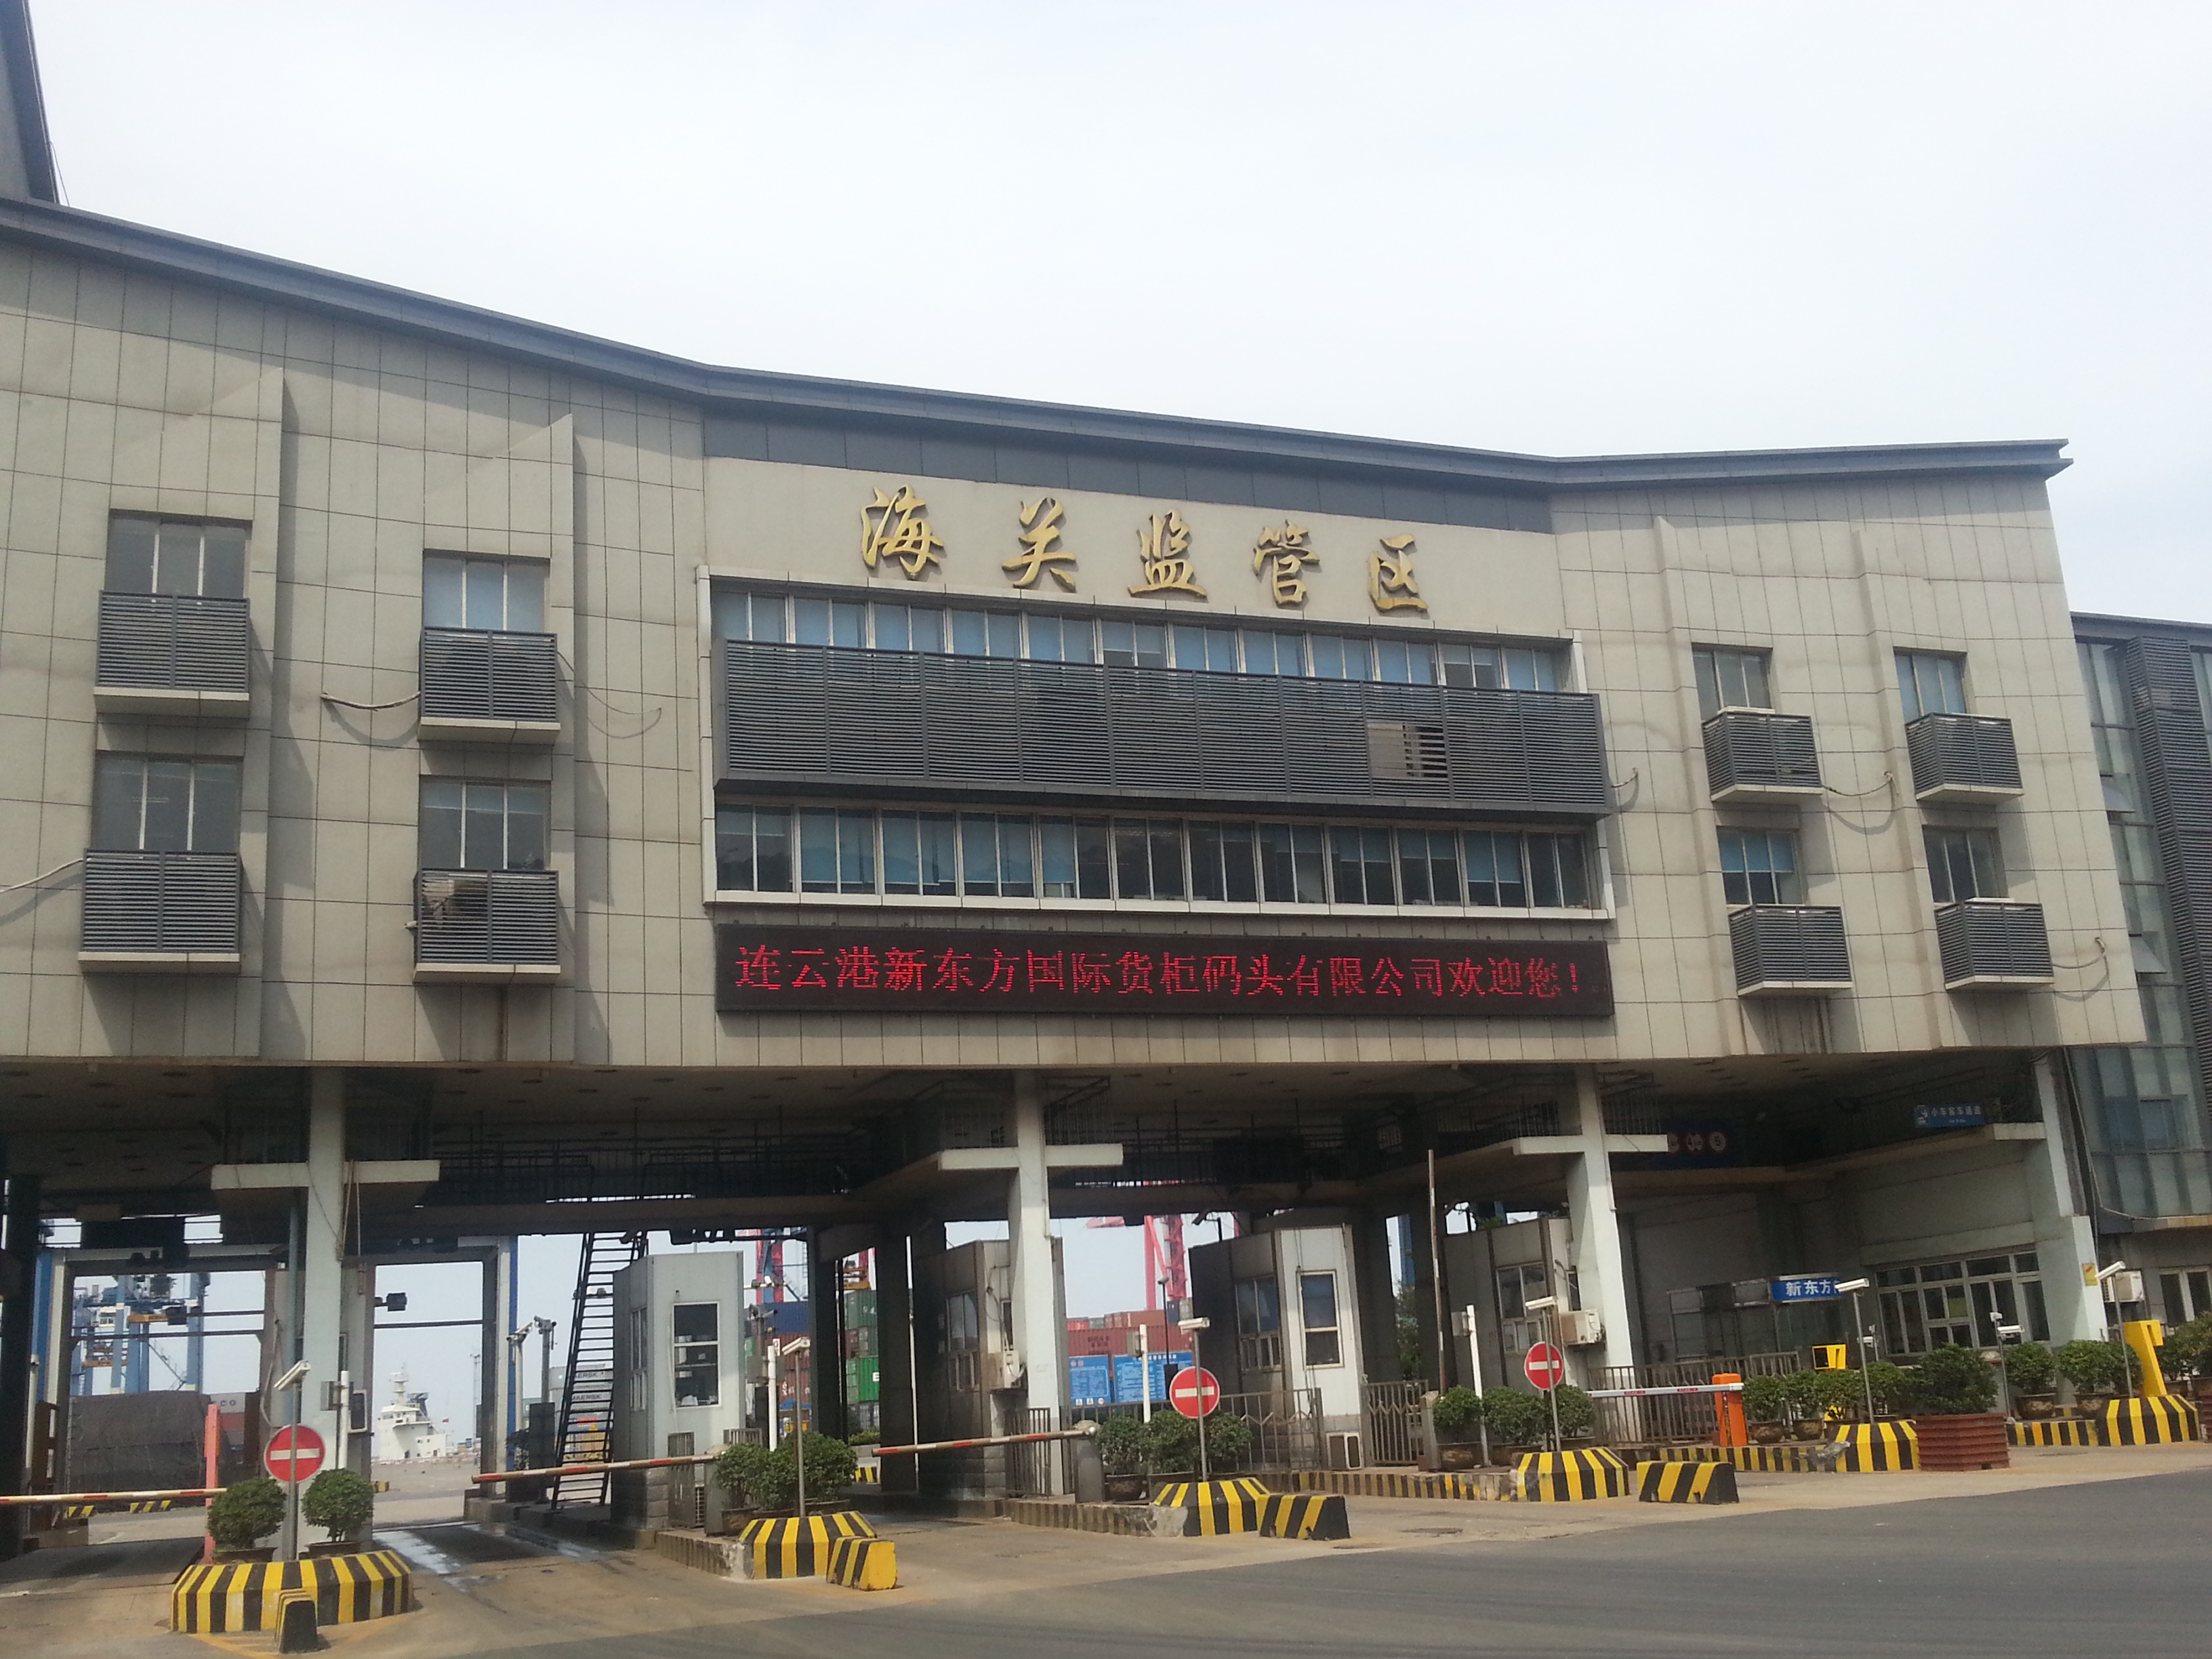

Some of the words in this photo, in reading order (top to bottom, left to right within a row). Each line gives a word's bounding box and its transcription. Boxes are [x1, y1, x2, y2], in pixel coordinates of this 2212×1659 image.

[860, 484, 1428, 613] 海关监管区
